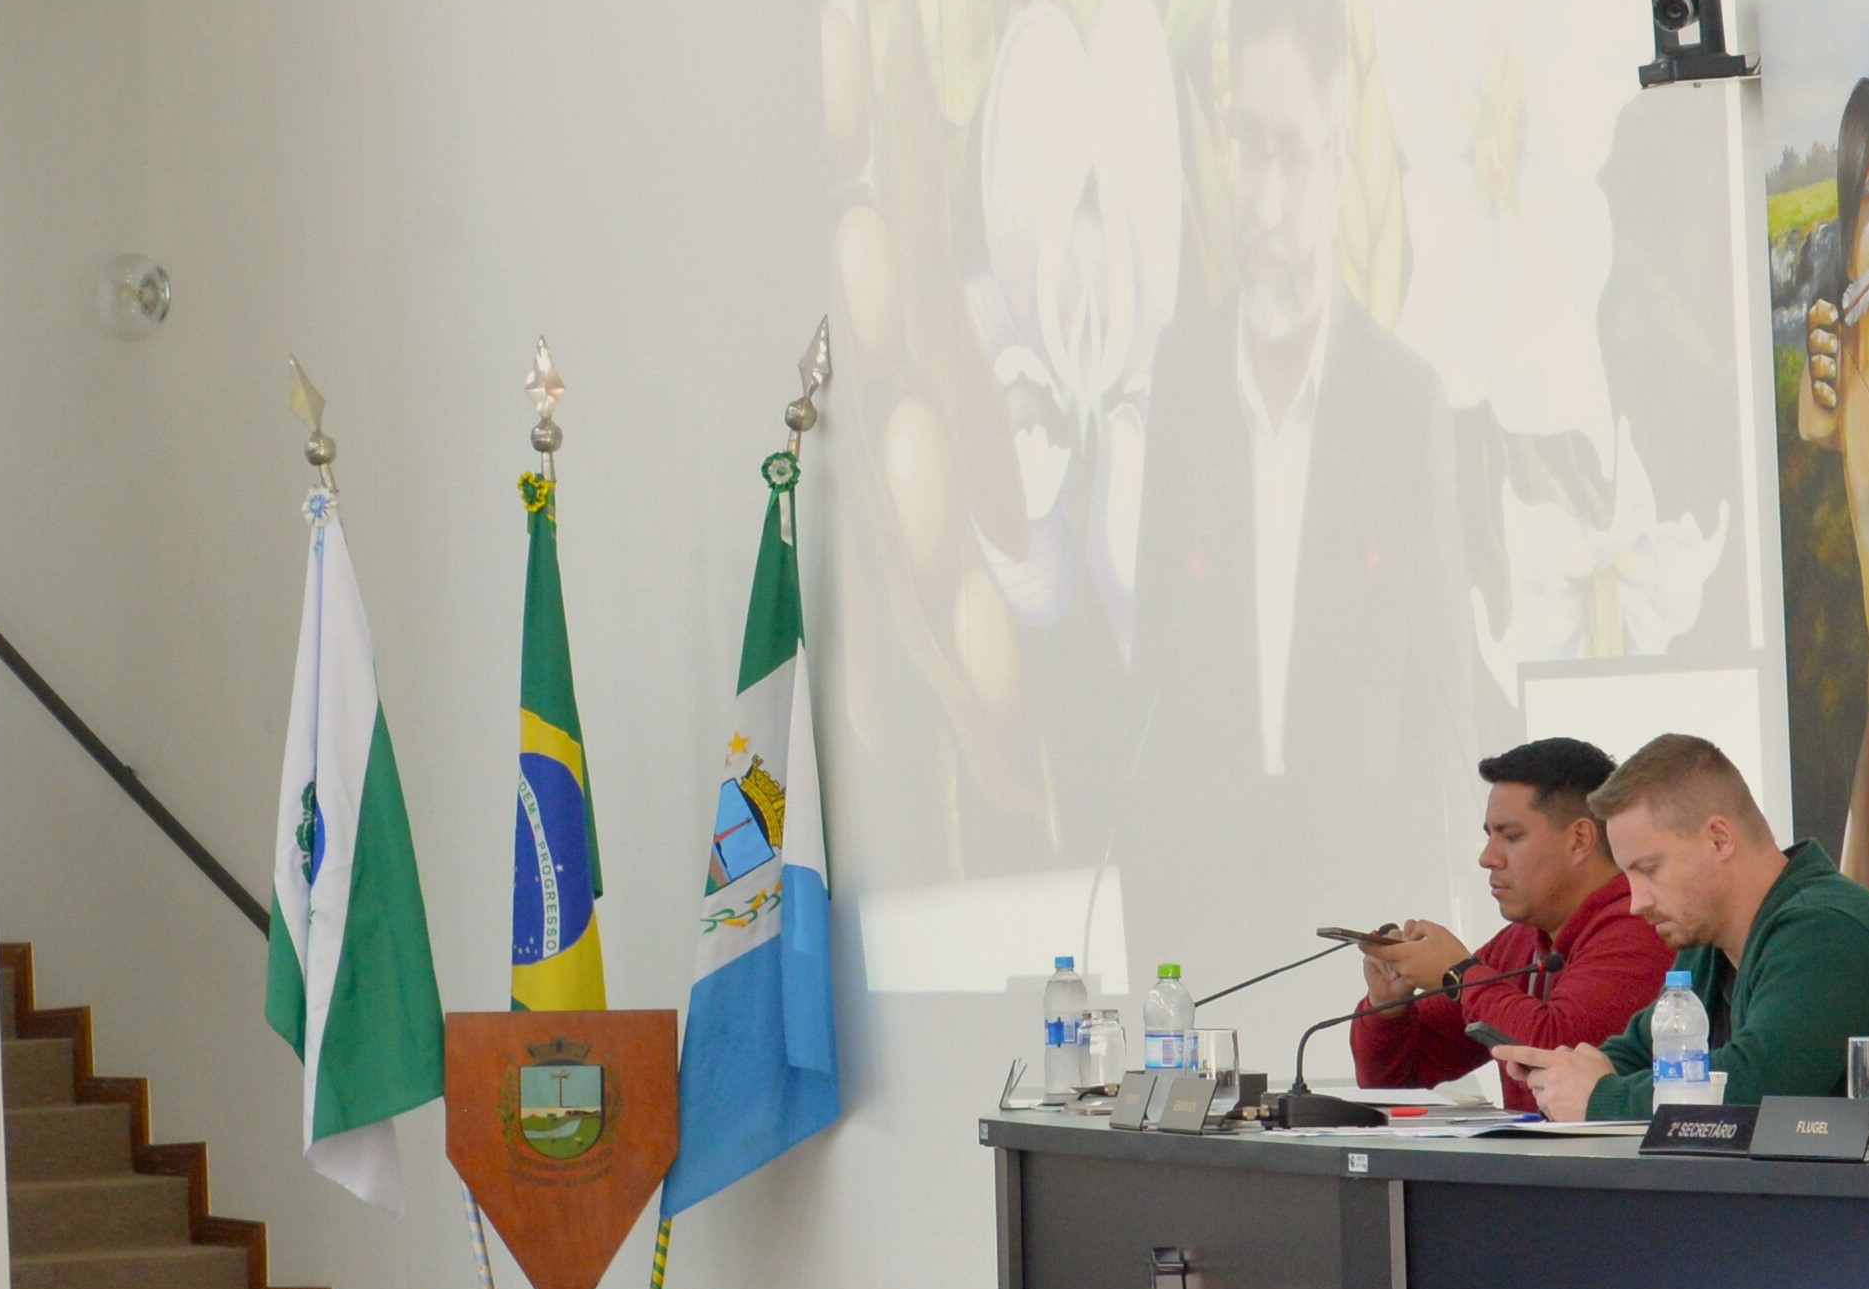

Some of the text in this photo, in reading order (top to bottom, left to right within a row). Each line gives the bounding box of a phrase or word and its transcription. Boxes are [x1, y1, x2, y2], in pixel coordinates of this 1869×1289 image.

[518, 779, 537, 814] DEM
[538, 841, 557, 951] PROGRESSO
[1678, 1119, 1737, 1139] SECRETÁRIO
[1796, 1120, 1829, 1134] FLUGEL
